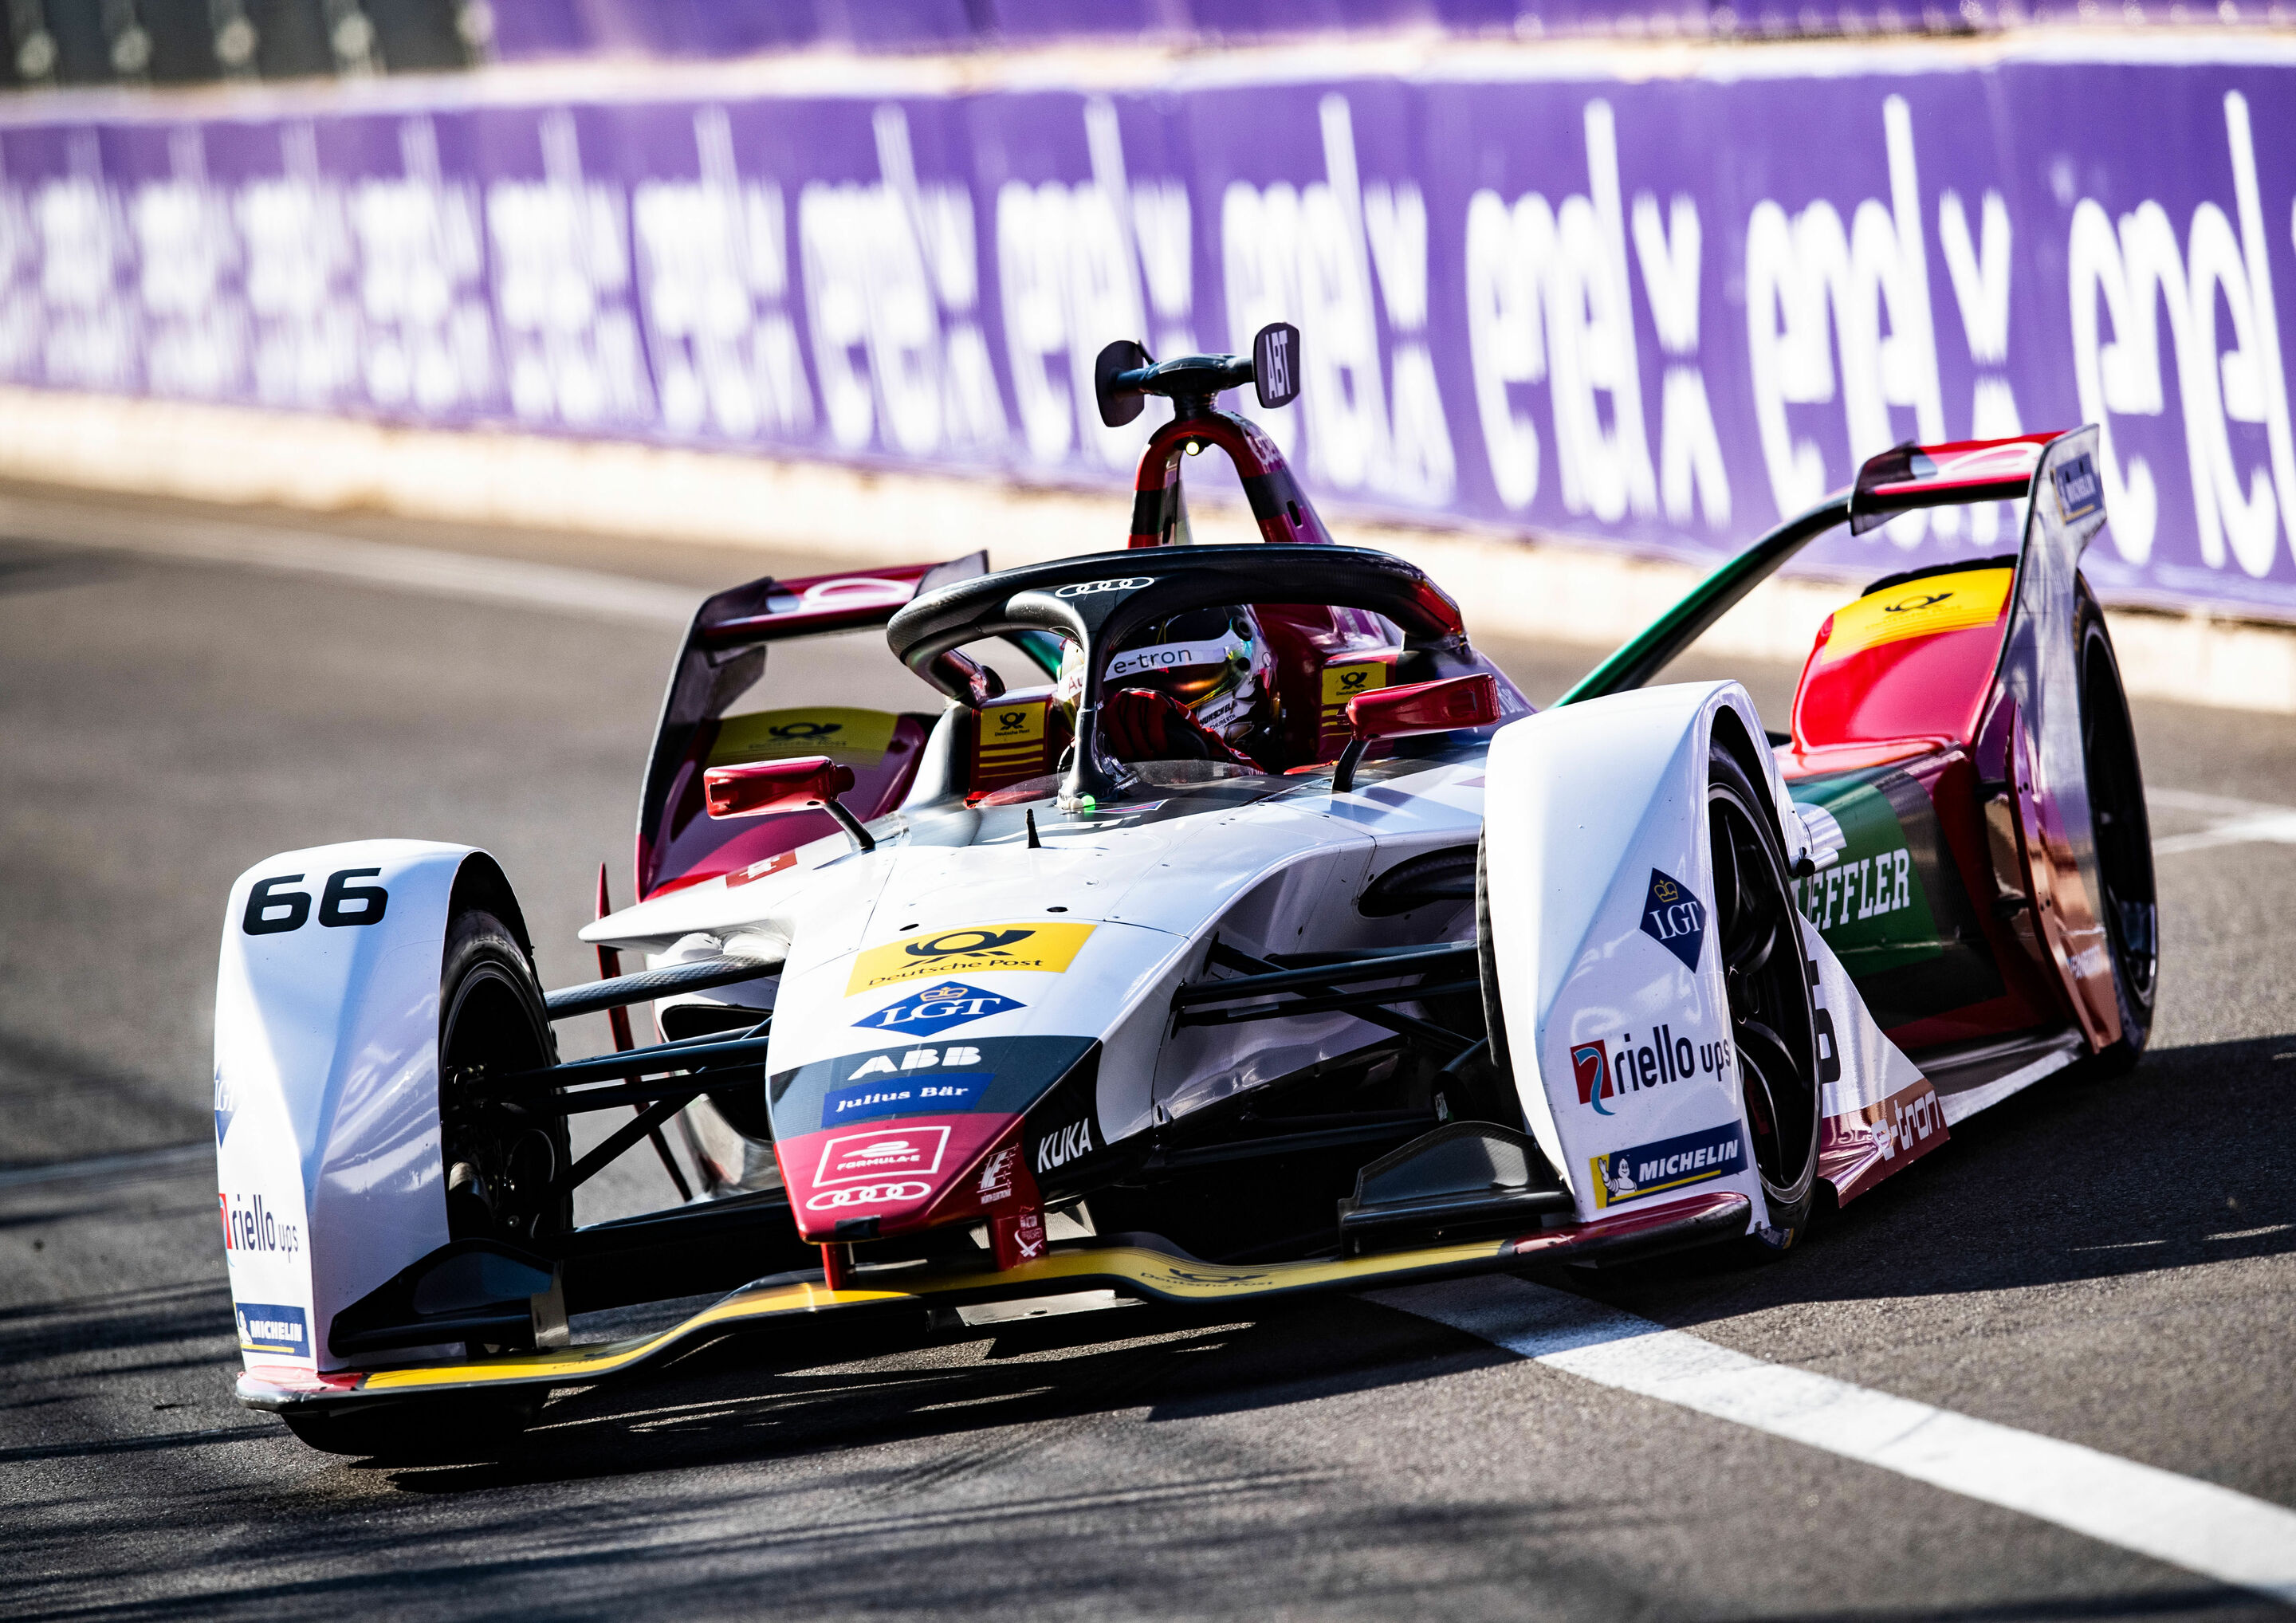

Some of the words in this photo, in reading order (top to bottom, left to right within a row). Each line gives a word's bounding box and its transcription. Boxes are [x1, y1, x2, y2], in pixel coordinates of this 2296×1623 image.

[1265, 330, 1291, 399] ABT
[1114, 649, 1192, 674] e-tron
[242, 867, 389, 936] 66
[1649, 901, 1701, 940] LGT
[868, 961, 981, 986] Deutsche
[875, 997, 1001, 1027] LGT
[847, 1047, 981, 1080] ABB
[1614, 1024, 1696, 1094] riello
[1700, 1039, 1731, 1082] ups
[835, 1091, 911, 1113] Julius
[919, 1086, 969, 1097] Bär
[1038, 1118, 1092, 1173] KUKA
[1871, 1090, 1940, 1161] e-tron
[1638, 1139, 1738, 1182] MICHELIN
[232, 1193, 276, 1252] riello
[278, 1224, 299, 1263] ups
[250, 1319, 303, 1342] MICHELIN
